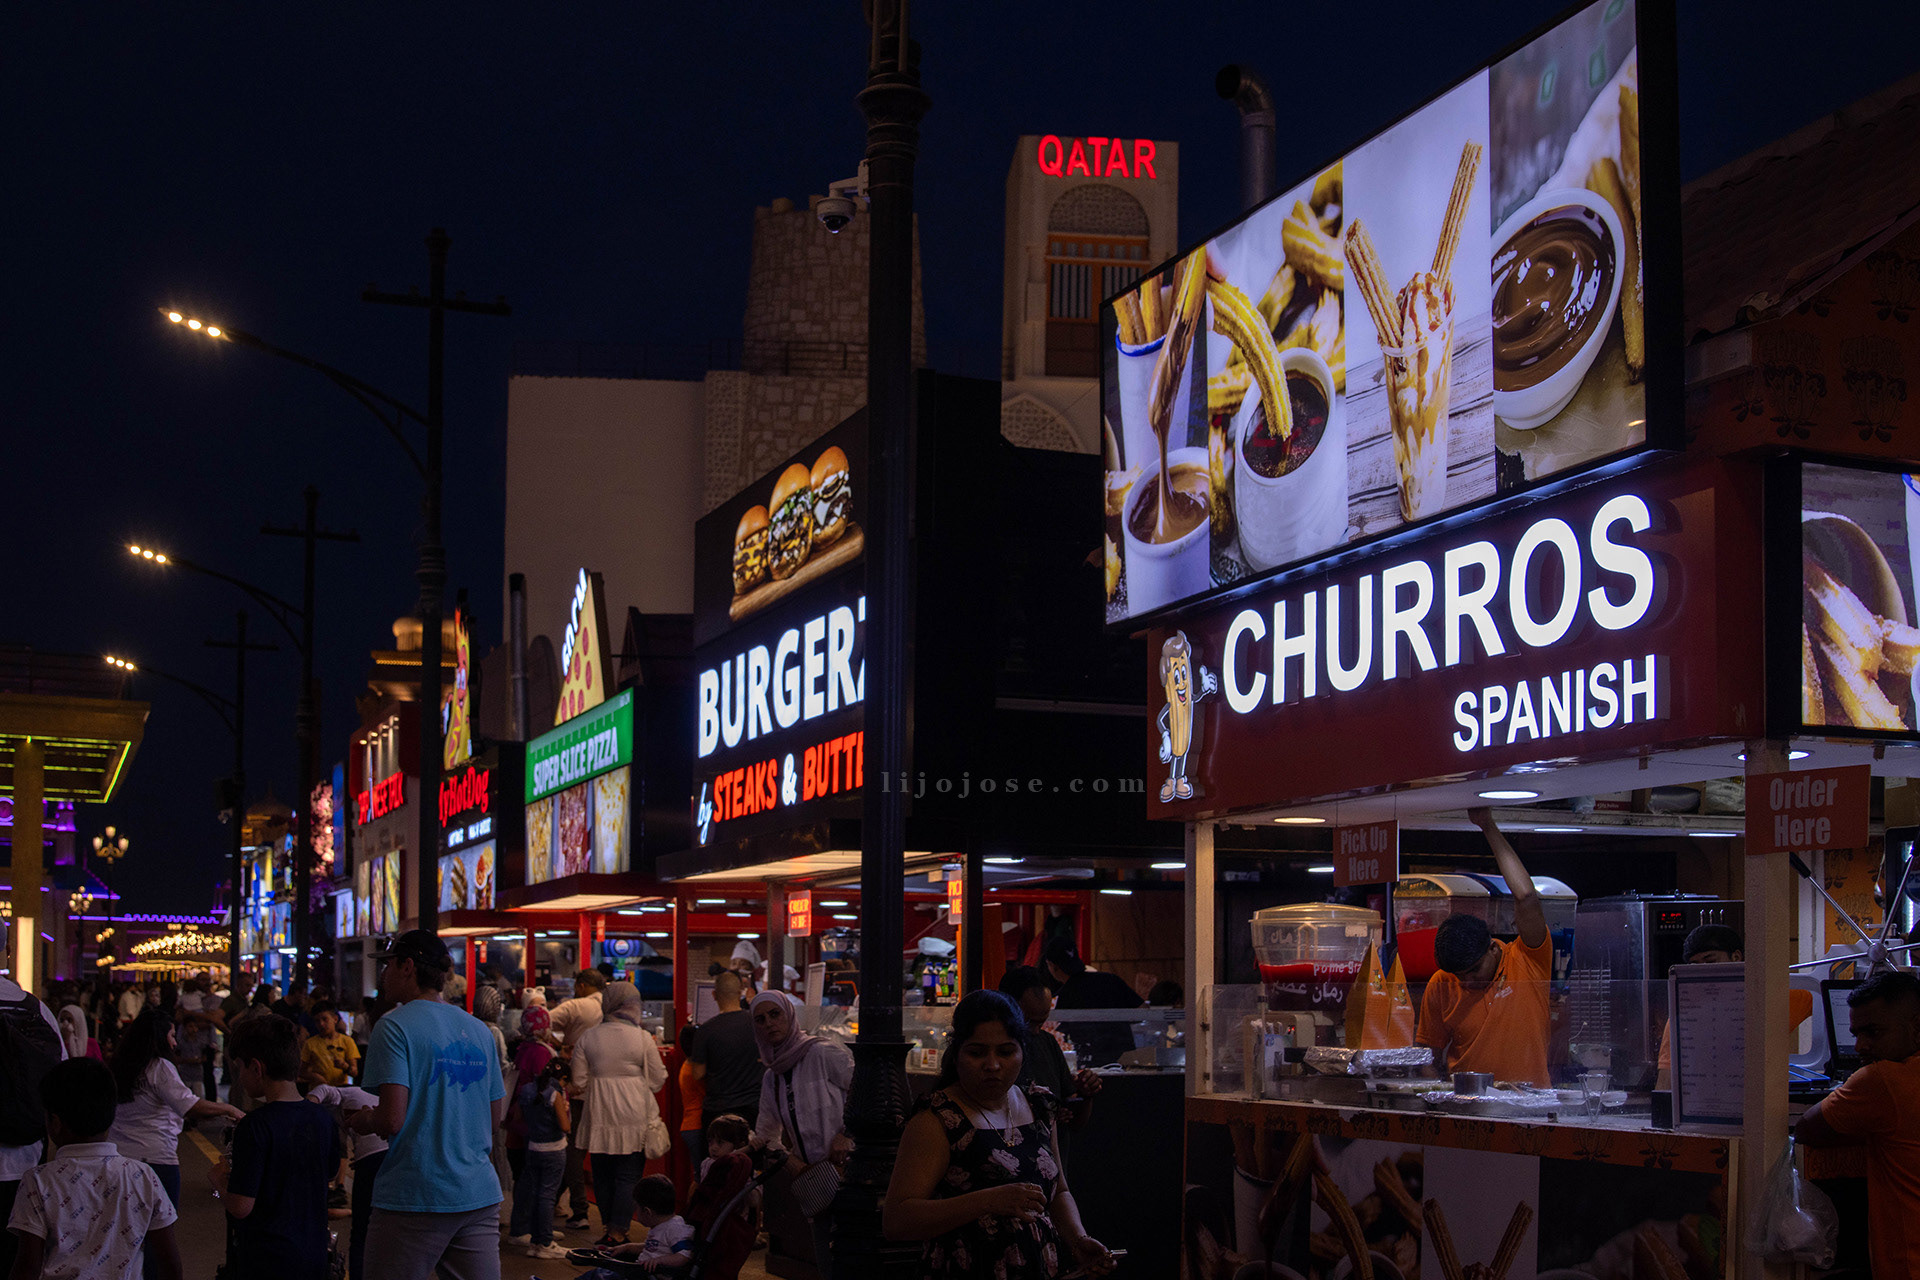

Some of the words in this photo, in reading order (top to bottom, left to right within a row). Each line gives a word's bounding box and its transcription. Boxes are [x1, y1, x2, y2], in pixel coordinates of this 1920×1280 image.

[1038, 134, 1157, 179] QATAR
[1222, 494, 1655, 715] CHURROS
[1452, 654, 1658, 753] SPANISH
[533, 754, 560, 797] SUPER
[560, 740, 587, 785] SLICE
[587, 726, 619, 774] PIZZA
[696, 782, 713, 845] by
[713, 758, 778, 824] STEAKS
[781, 752, 798, 806] &
[1769, 775, 1838, 811] Order
[1340, 828, 1368, 855] Pick
[1369, 826, 1388, 853] Up
[1774, 814, 1831, 848] Here
[1348, 856, 1379, 882] Here
